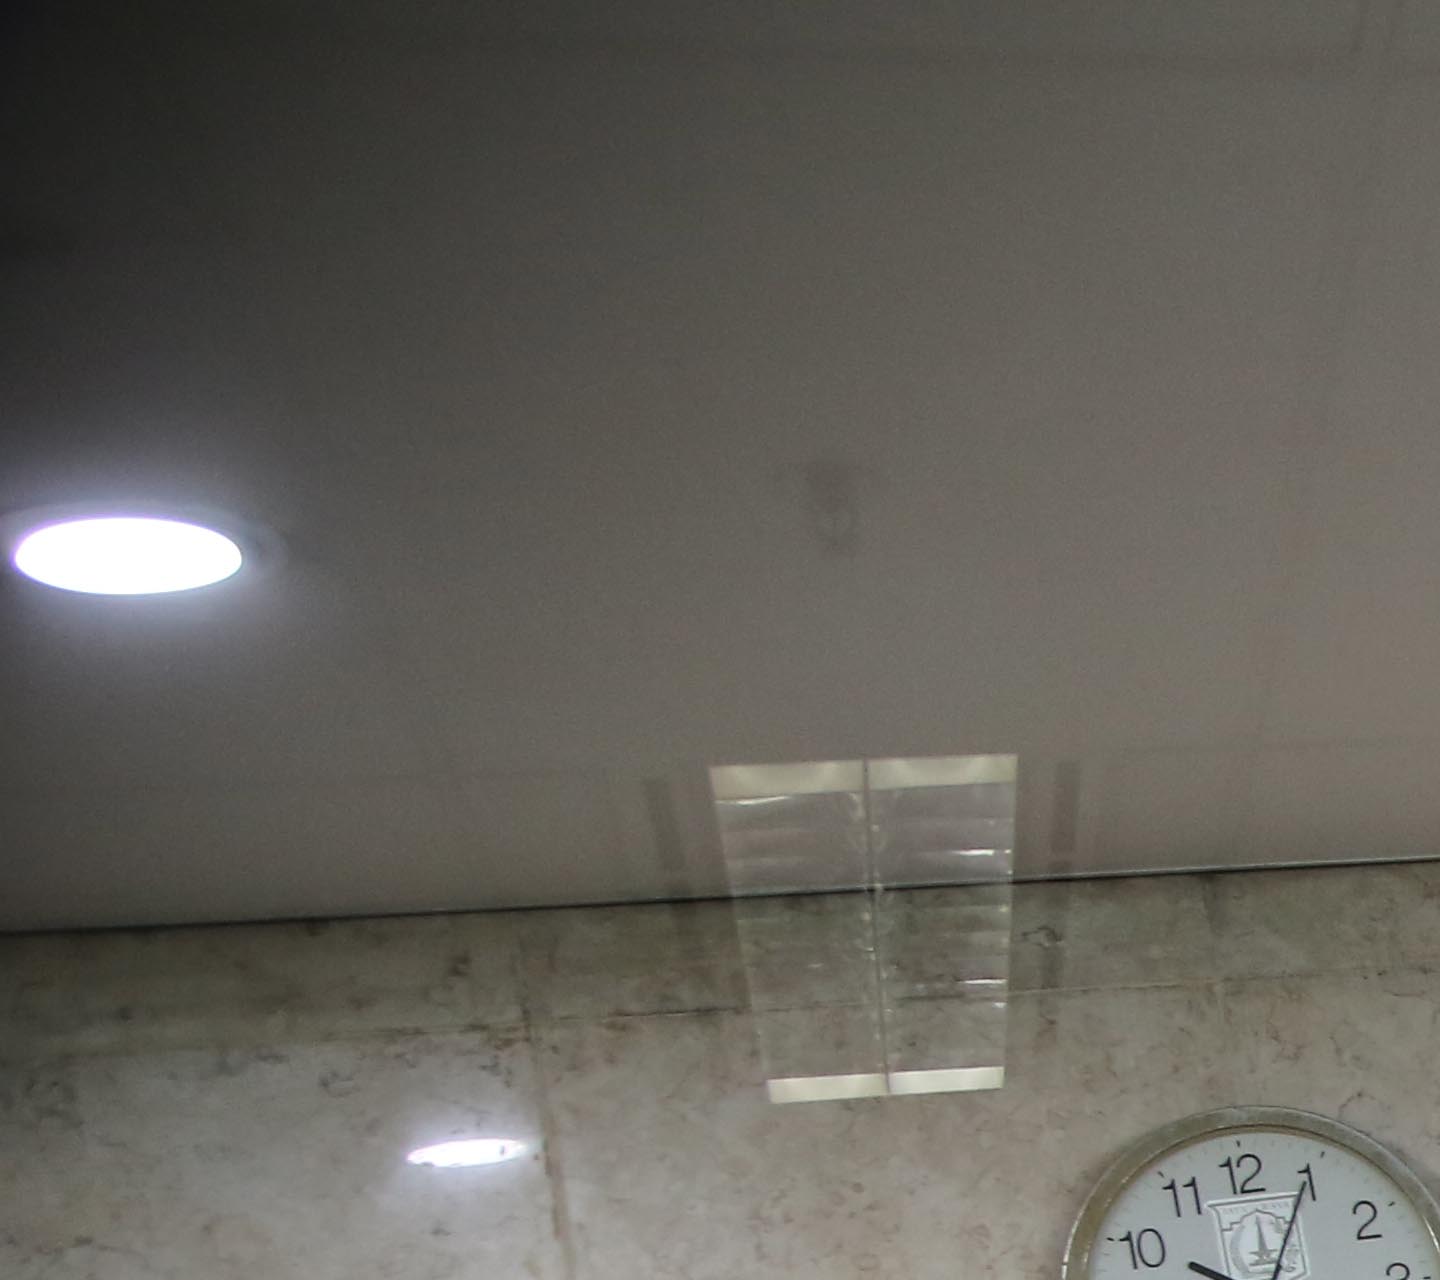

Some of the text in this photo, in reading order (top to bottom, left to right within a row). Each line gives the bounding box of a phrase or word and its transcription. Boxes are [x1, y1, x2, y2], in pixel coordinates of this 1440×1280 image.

[1218, 1153, 1266, 1195] 12
[1297, 1163, 1317, 1201] 1
[1163, 1176, 1202, 1217] 11
[1353, 1200, 1382, 1240] 2
[1119, 1228, 1166, 1269] 10
